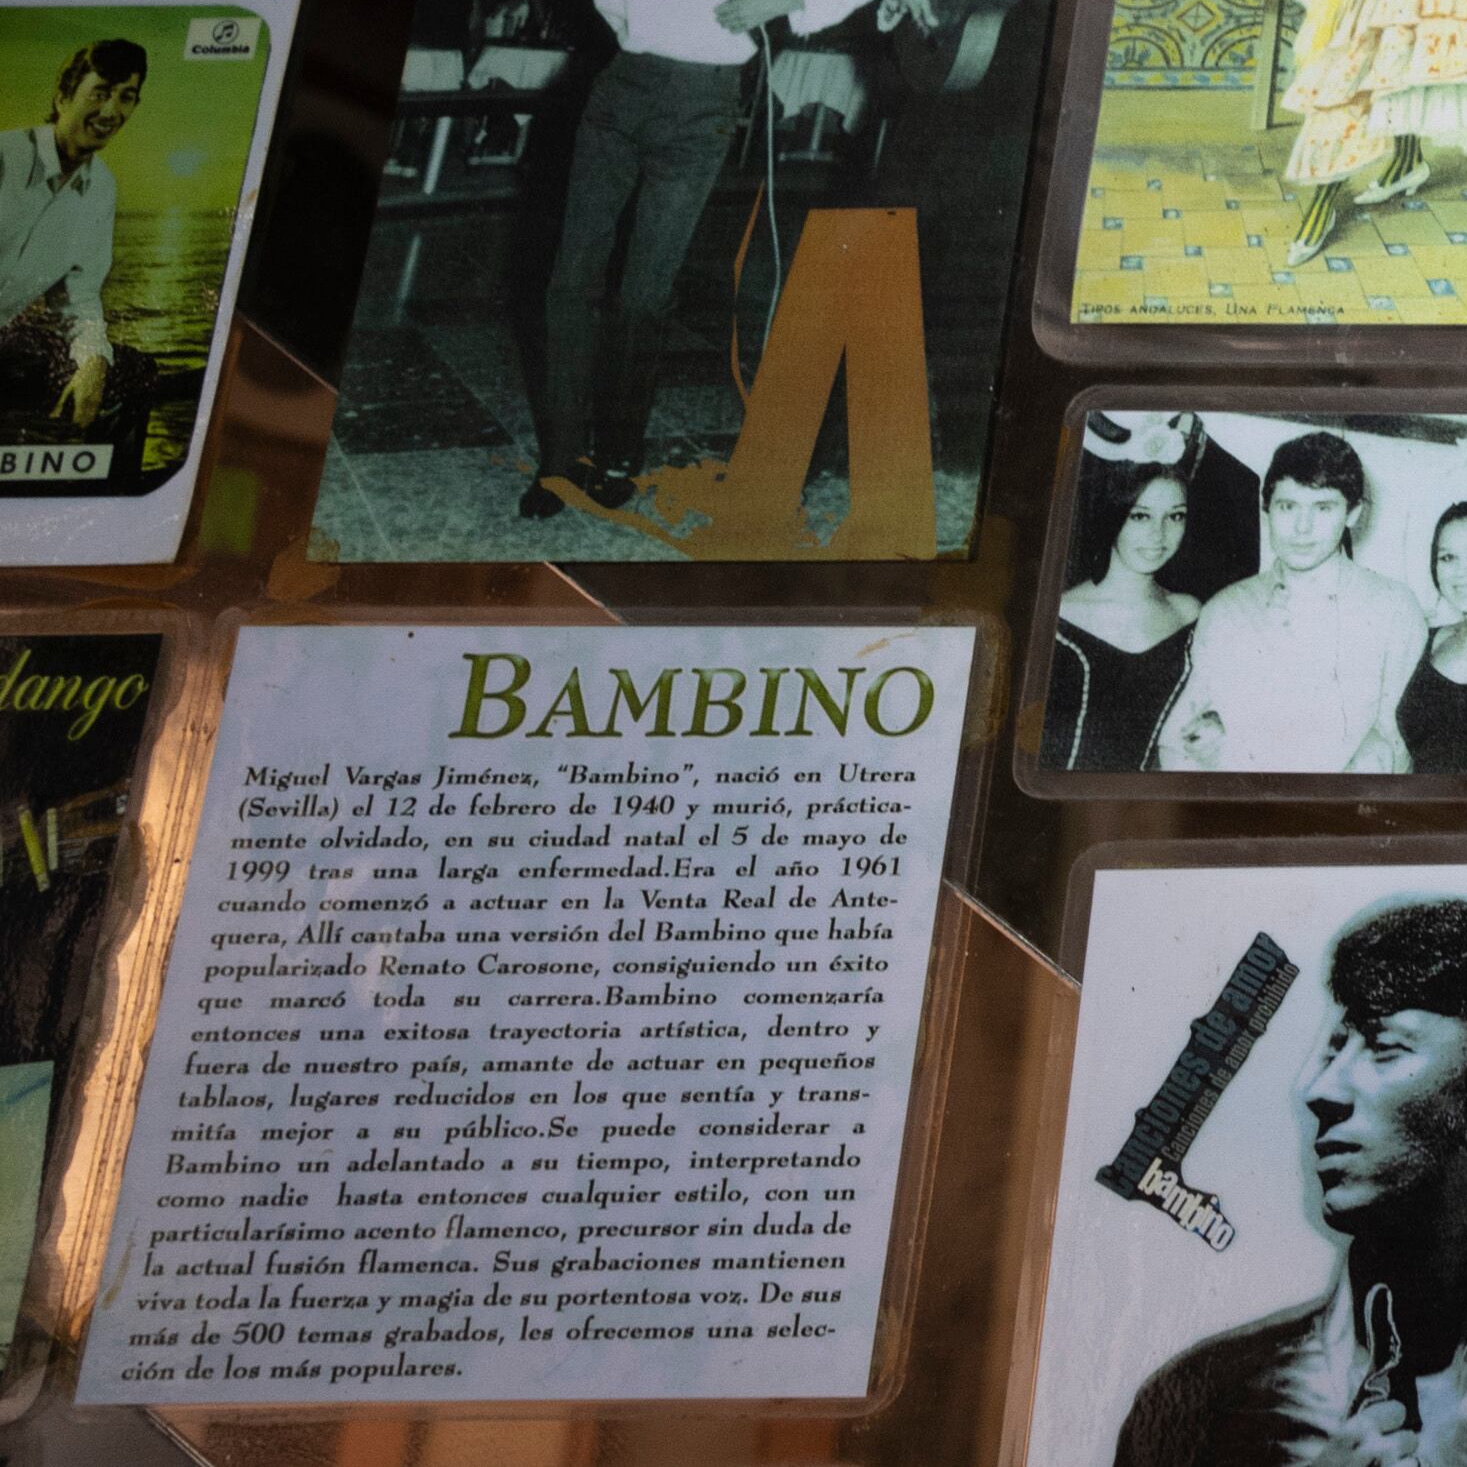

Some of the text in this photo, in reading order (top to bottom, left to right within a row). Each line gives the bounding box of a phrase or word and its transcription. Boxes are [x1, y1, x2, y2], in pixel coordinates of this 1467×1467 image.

[192, 45, 250, 55] Columbia
[449, 650, 935, 739] BAMBINO
[243, 759, 916, 792] Miguel Vargas Jiménez, “Bambino”, nació en Utrera
[237, 790, 912, 822] (Sevilla) el 12 de febrero de 1940 y murió, práctica-
[230, 820, 908, 852] mente olvidado, en su ciudad natal el 5 de mayo de
[227, 859, 291, 883] 1999
[308, 863, 353, 880] tras
[372, 866, 418, 880] una
[437, 854, 499, 885] larga
[734, 852, 757, 878] el
[773, 859, 820, 877] año
[841, 853, 900, 878] 1961
[216, 883, 898, 913] cuando comenzó a actuar en la Venta Real de Ante-
[209, 915, 894, 951] quera, Allí cantaba una versión del Bambino que había
[203, 947, 889, 983] popularizado Renato Carosone, consiguiendo un éxito
[196, 996, 243, 1015] que
[268, 989, 347, 1009] marcó
[372, 982, 426, 1008] toda
[452, 993, 481, 1008] su
[742, 985, 884, 1006] comenzaría
[189, 1012, 880, 1046] entonces una exitosa trayectoria artística, dentro y
[183, 1046, 876, 1078] fuera de nuestro país, amante de actuar en pequeños
[1097, 934, 1284, 1200] Canciones de amor
[1161, 961, 1298, 1163] Canciones de amor prohibido
[177, 1078, 870, 1113] tablaos, lugares reducidos en los que sentía y trans-
[1137, 1156, 1236, 1252] bambino
[119, 1350, 463, 1385] ción de los más populares.
